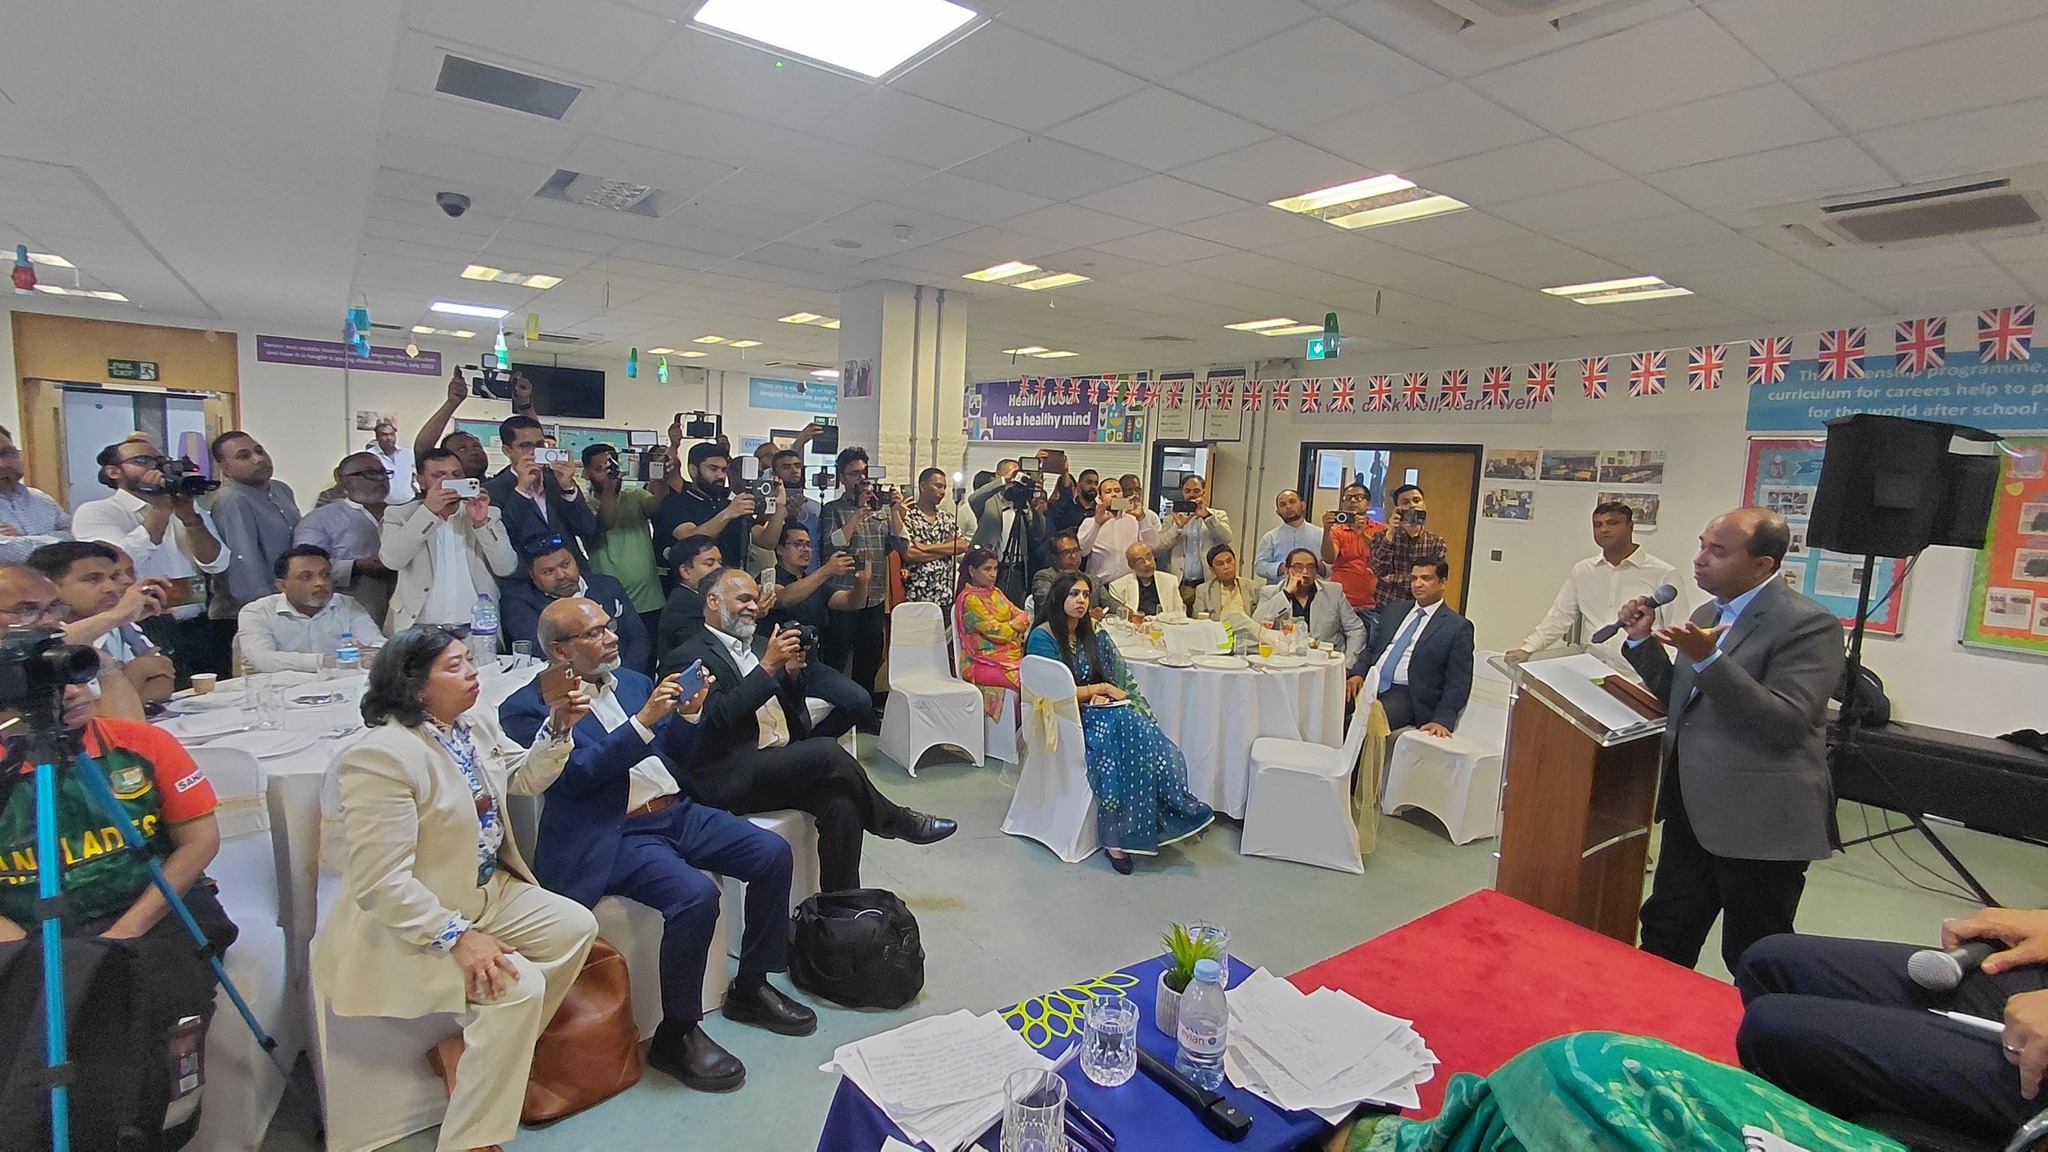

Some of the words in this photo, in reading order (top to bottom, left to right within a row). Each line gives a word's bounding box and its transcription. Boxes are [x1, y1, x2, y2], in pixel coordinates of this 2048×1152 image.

[1767, 387, 1852, 401] curriculum
[1856, 386, 1881, 399] for
[1885, 385, 1951, 398] careers
[1956, 382, 1999, 398] help
[2003, 383, 2026, 395] to
[1808, 405, 1831, 418] for
[1835, 405, 1862, 418] the
[1866, 403, 1918, 418] world
[1922, 402, 1969, 417] after
[1972, 400, 2038, 417] school
[992, 412, 1014, 427] fuels
[1015, 416, 1022, 426] a
[1023, 411, 1060, 429] healthy
[1061, 411, 1091, 426] mind
[1181, 1029, 1205, 1046] evian
